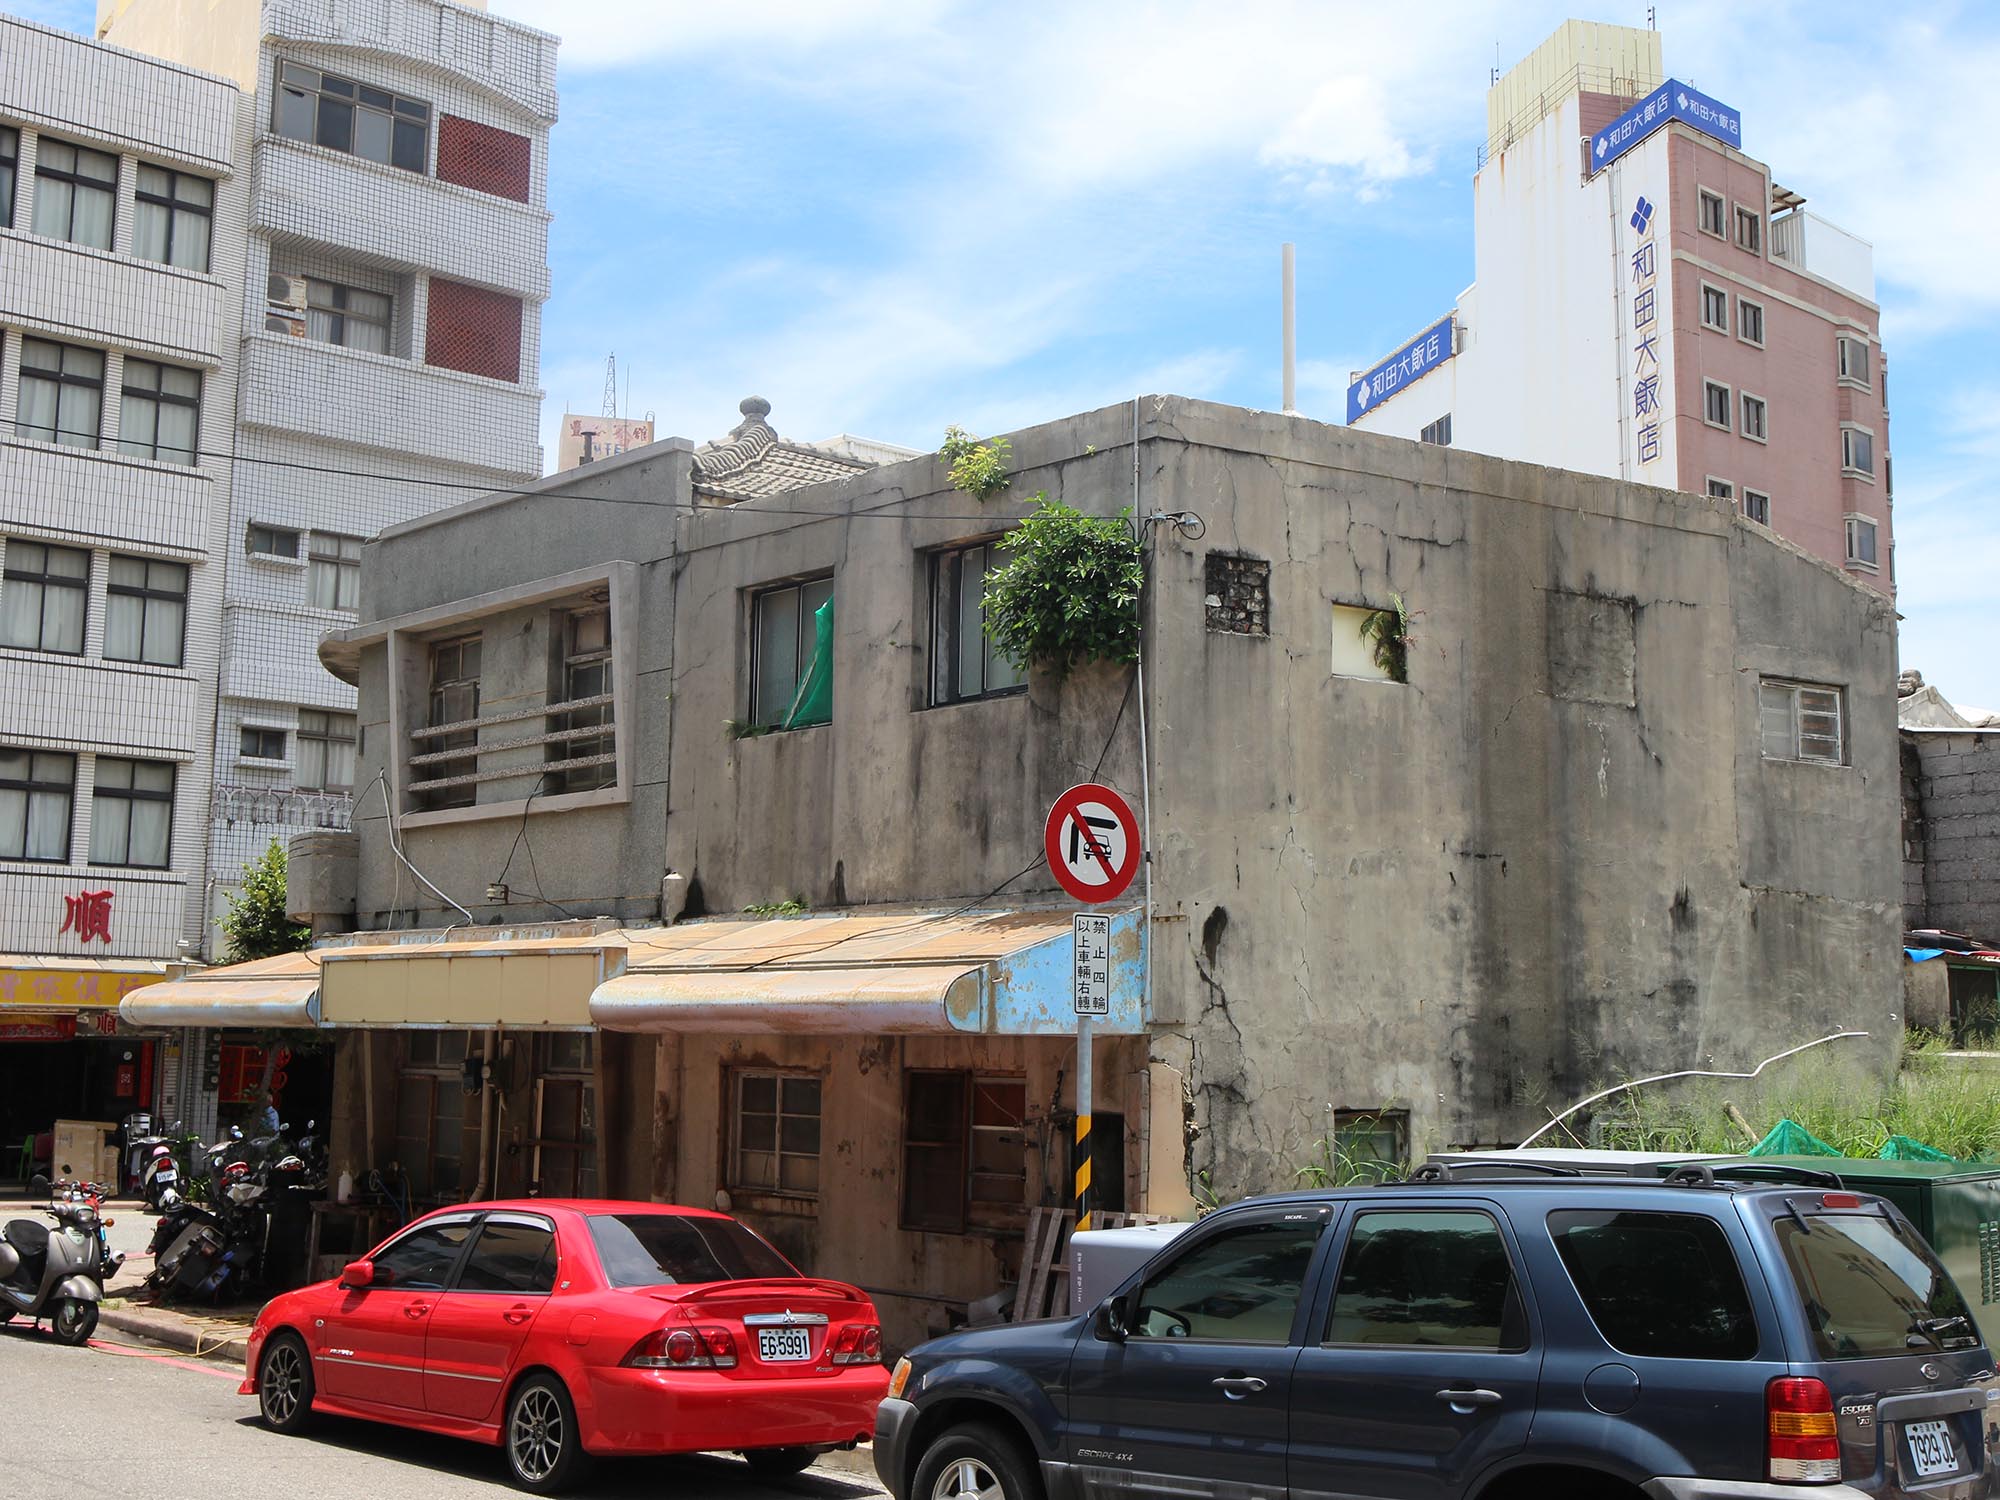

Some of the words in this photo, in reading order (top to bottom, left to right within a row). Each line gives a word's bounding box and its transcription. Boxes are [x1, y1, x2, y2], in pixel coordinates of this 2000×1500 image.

[1609, 92, 1669, 149] 和田大飯店
[1688, 98, 1739, 136] 和田大飯店
[1371, 334, 1440, 398] 和田大飯店
[1631, 241, 1660, 466] 和田大飯店
[60, 889, 115, 945] 順
[1077, 920, 1091, 1010] 以上車輛右轉
[1093, 921, 1106, 1010] 禁止四輪
[96, 1011, 118, 1035] 順
[760, 1335, 808, 1356] E6-5991
[1840, 1404, 1874, 1415] ESCAPE
[1077, 1448, 1114, 1460] ESCAPE
[1115, 1453, 1134, 1462] 4X4
[1909, 1431, 1956, 1468] 7929-JD
